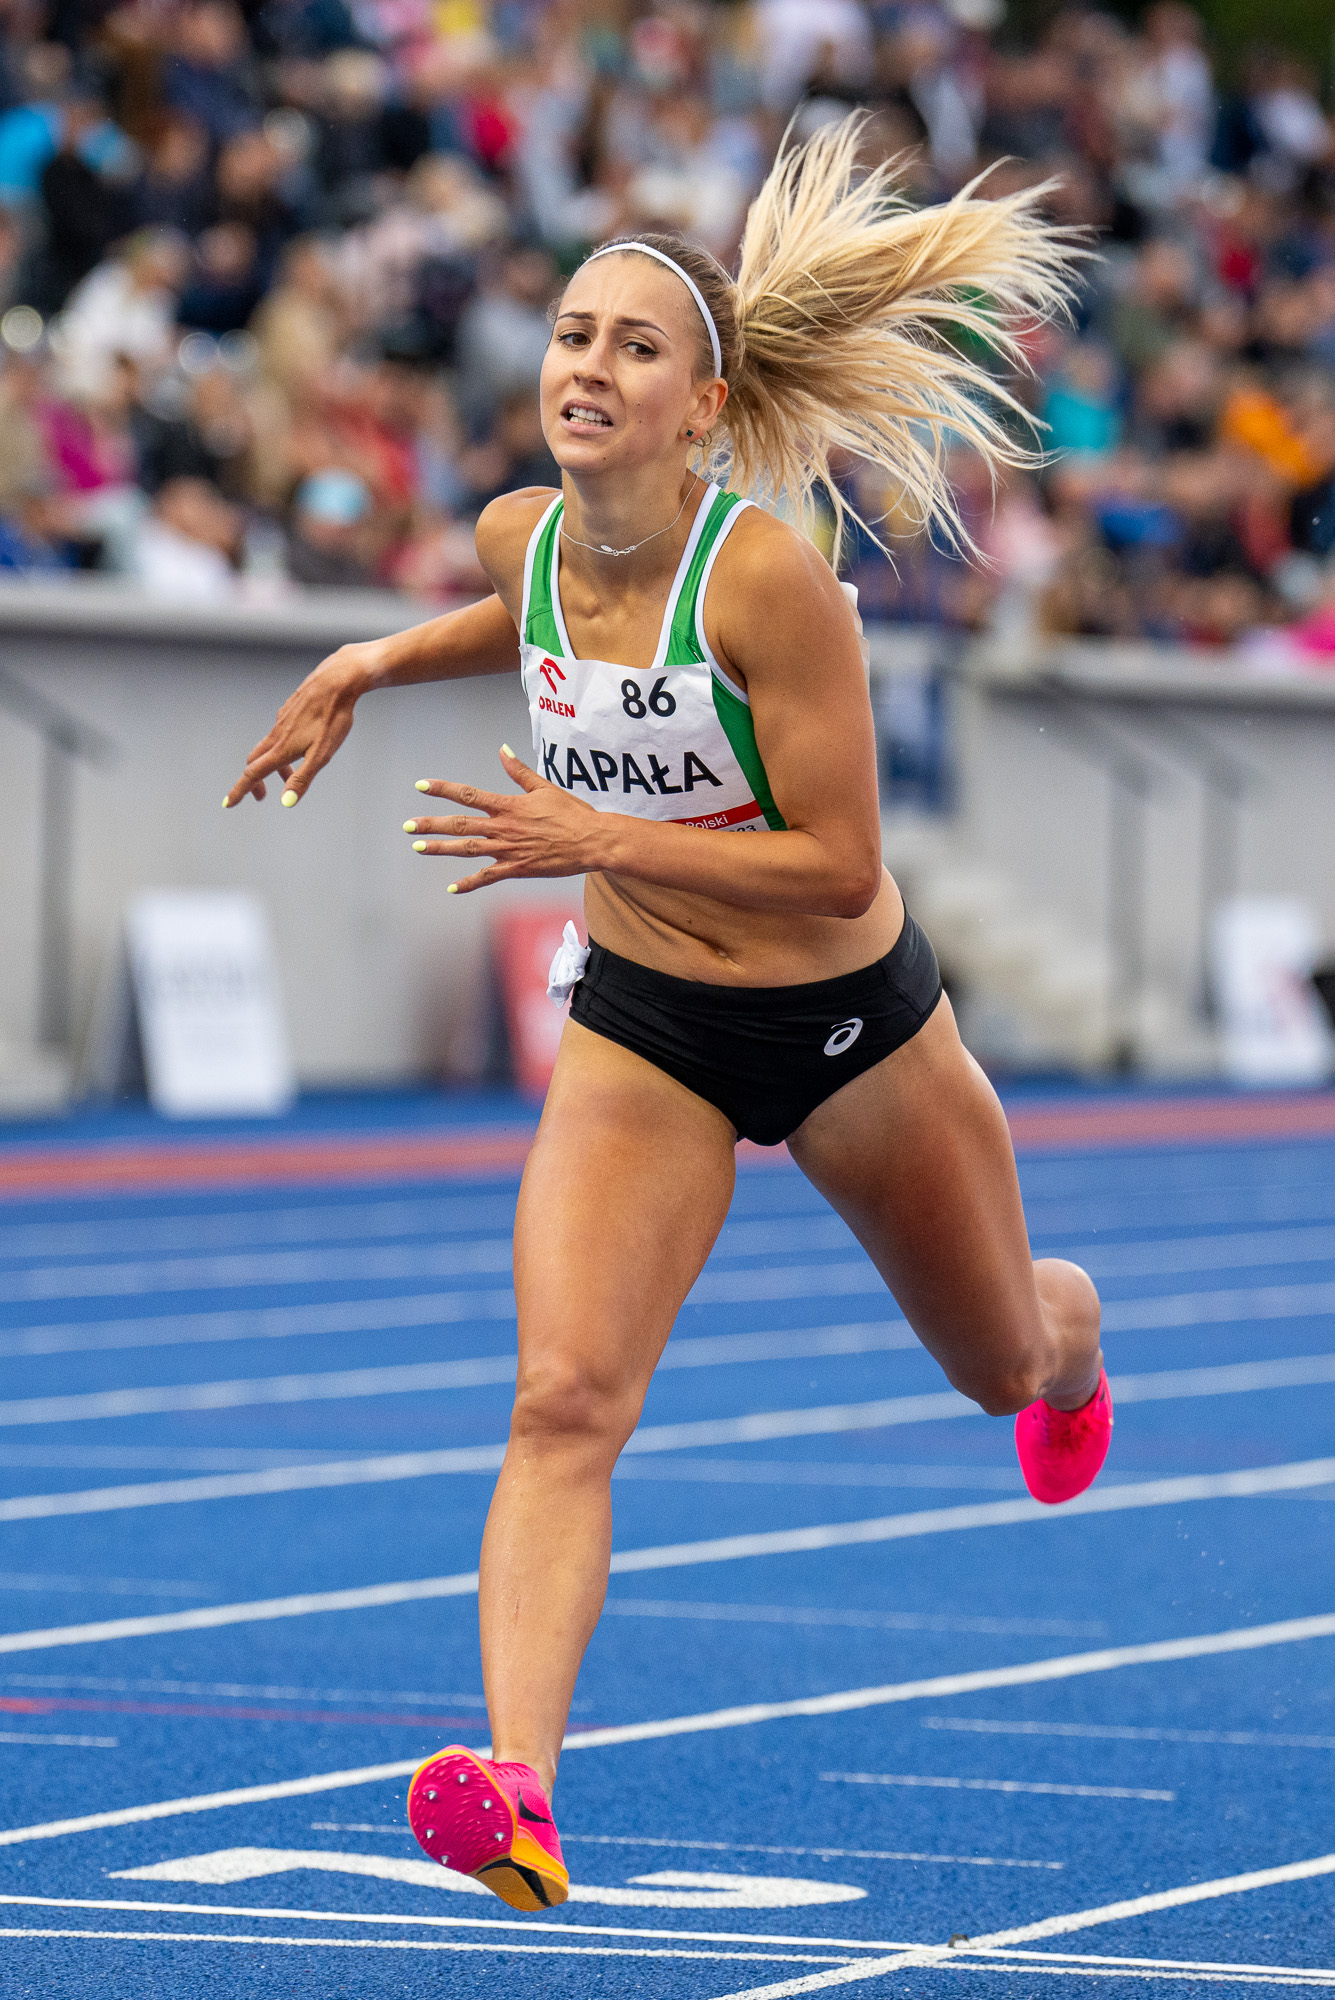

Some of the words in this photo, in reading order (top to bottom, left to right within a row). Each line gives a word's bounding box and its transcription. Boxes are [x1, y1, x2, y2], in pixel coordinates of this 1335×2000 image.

[539, 696, 576, 718] ORLEN
[621, 676, 677, 719] 86
[543, 738, 724, 795] KAPAŁA
